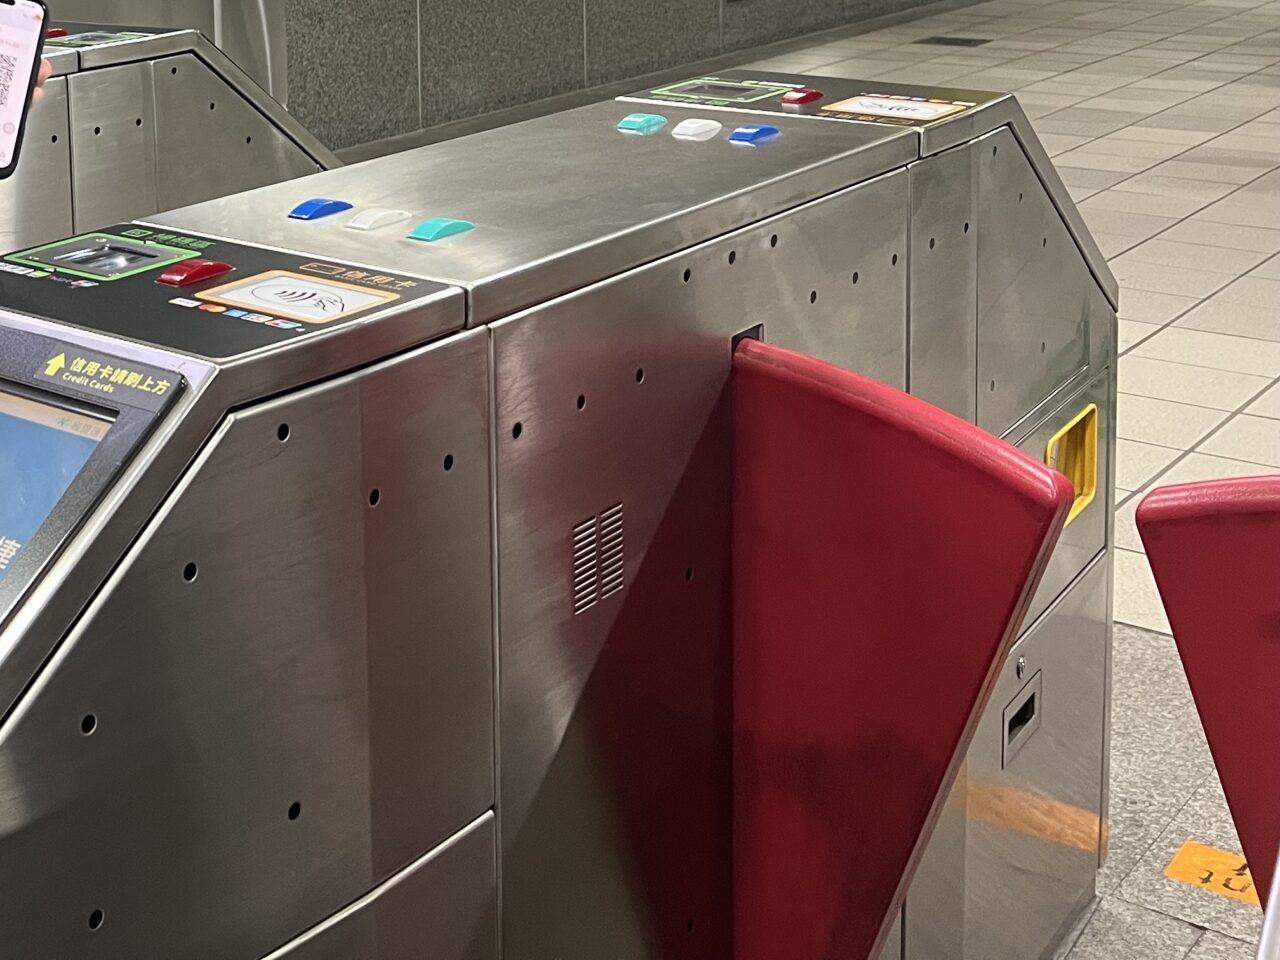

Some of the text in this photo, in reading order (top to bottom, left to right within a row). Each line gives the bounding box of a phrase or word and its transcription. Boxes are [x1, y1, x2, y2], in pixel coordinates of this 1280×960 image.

[62, 372, 115, 393] Credit Cards
[69, 357, 171, 395] 信用卡請刷上方
